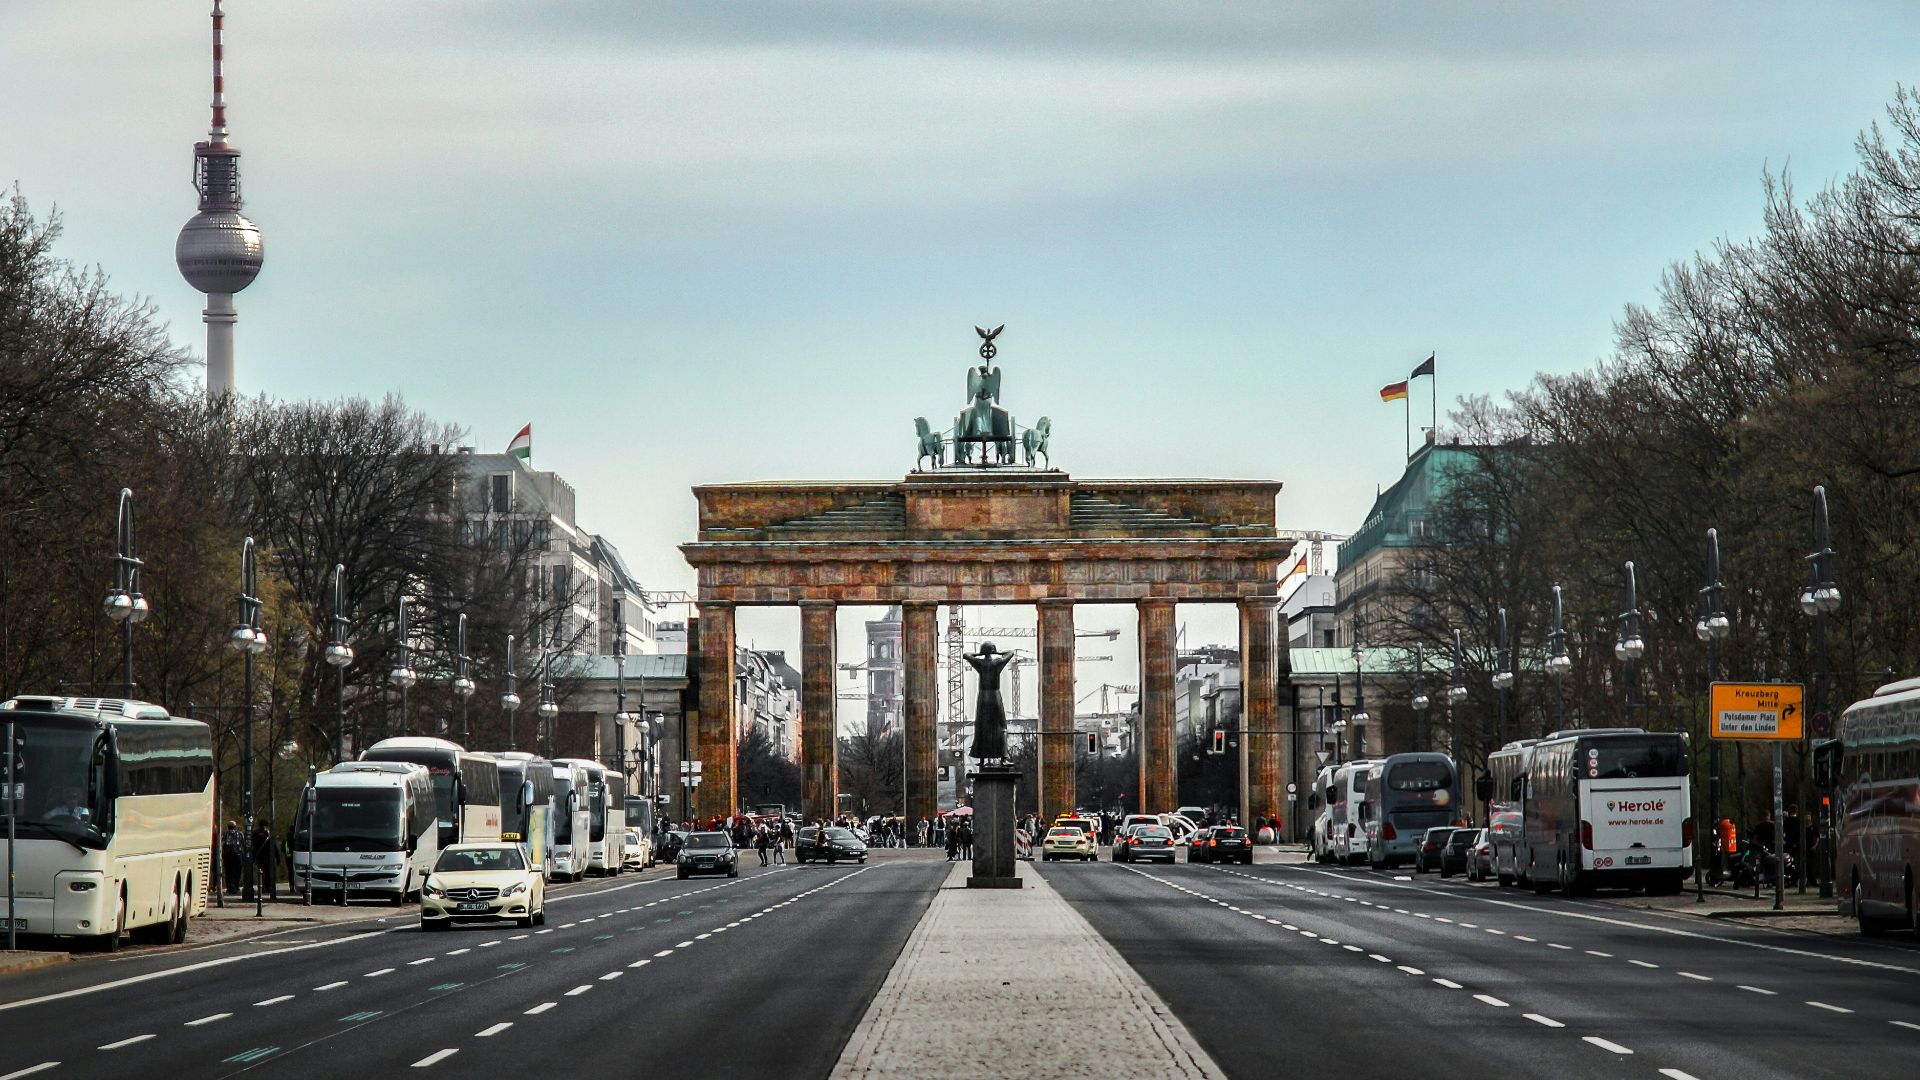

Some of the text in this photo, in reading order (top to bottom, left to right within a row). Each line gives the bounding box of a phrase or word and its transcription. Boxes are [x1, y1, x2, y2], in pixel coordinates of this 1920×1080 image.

[1735, 690, 1779, 699] Kreuzberg
[1757, 700, 1778, 708] Mitte
[1724, 712, 1776, 721] Potsdamer Platz
[1721, 723, 1776, 731] Unter den Linden
[1618, 799, 1664, 812] Herolé
[1608, 818, 1664, 826] www.herole.de
